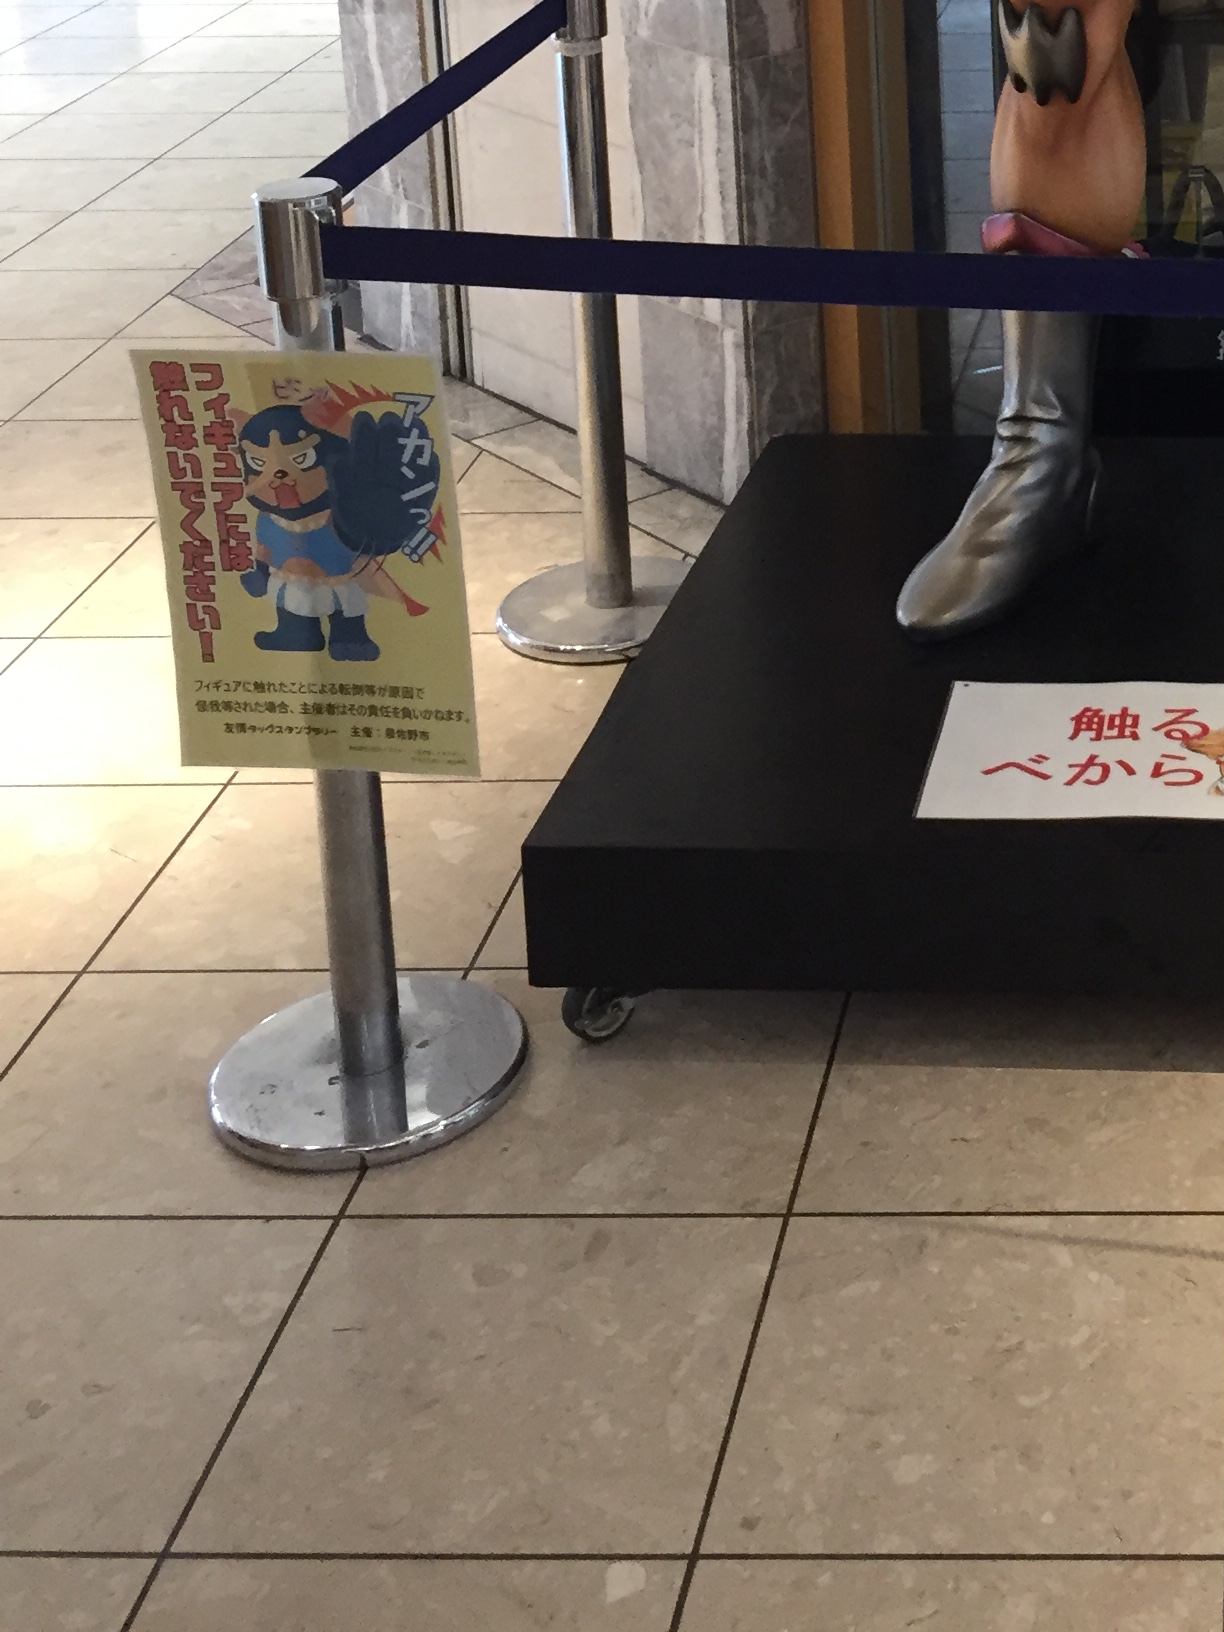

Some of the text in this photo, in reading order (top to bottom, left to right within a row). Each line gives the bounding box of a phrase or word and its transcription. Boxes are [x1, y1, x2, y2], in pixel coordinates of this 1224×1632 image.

[189, 361, 255, 573] フィギュアには
[1067, 705, 1212, 743] 触る
